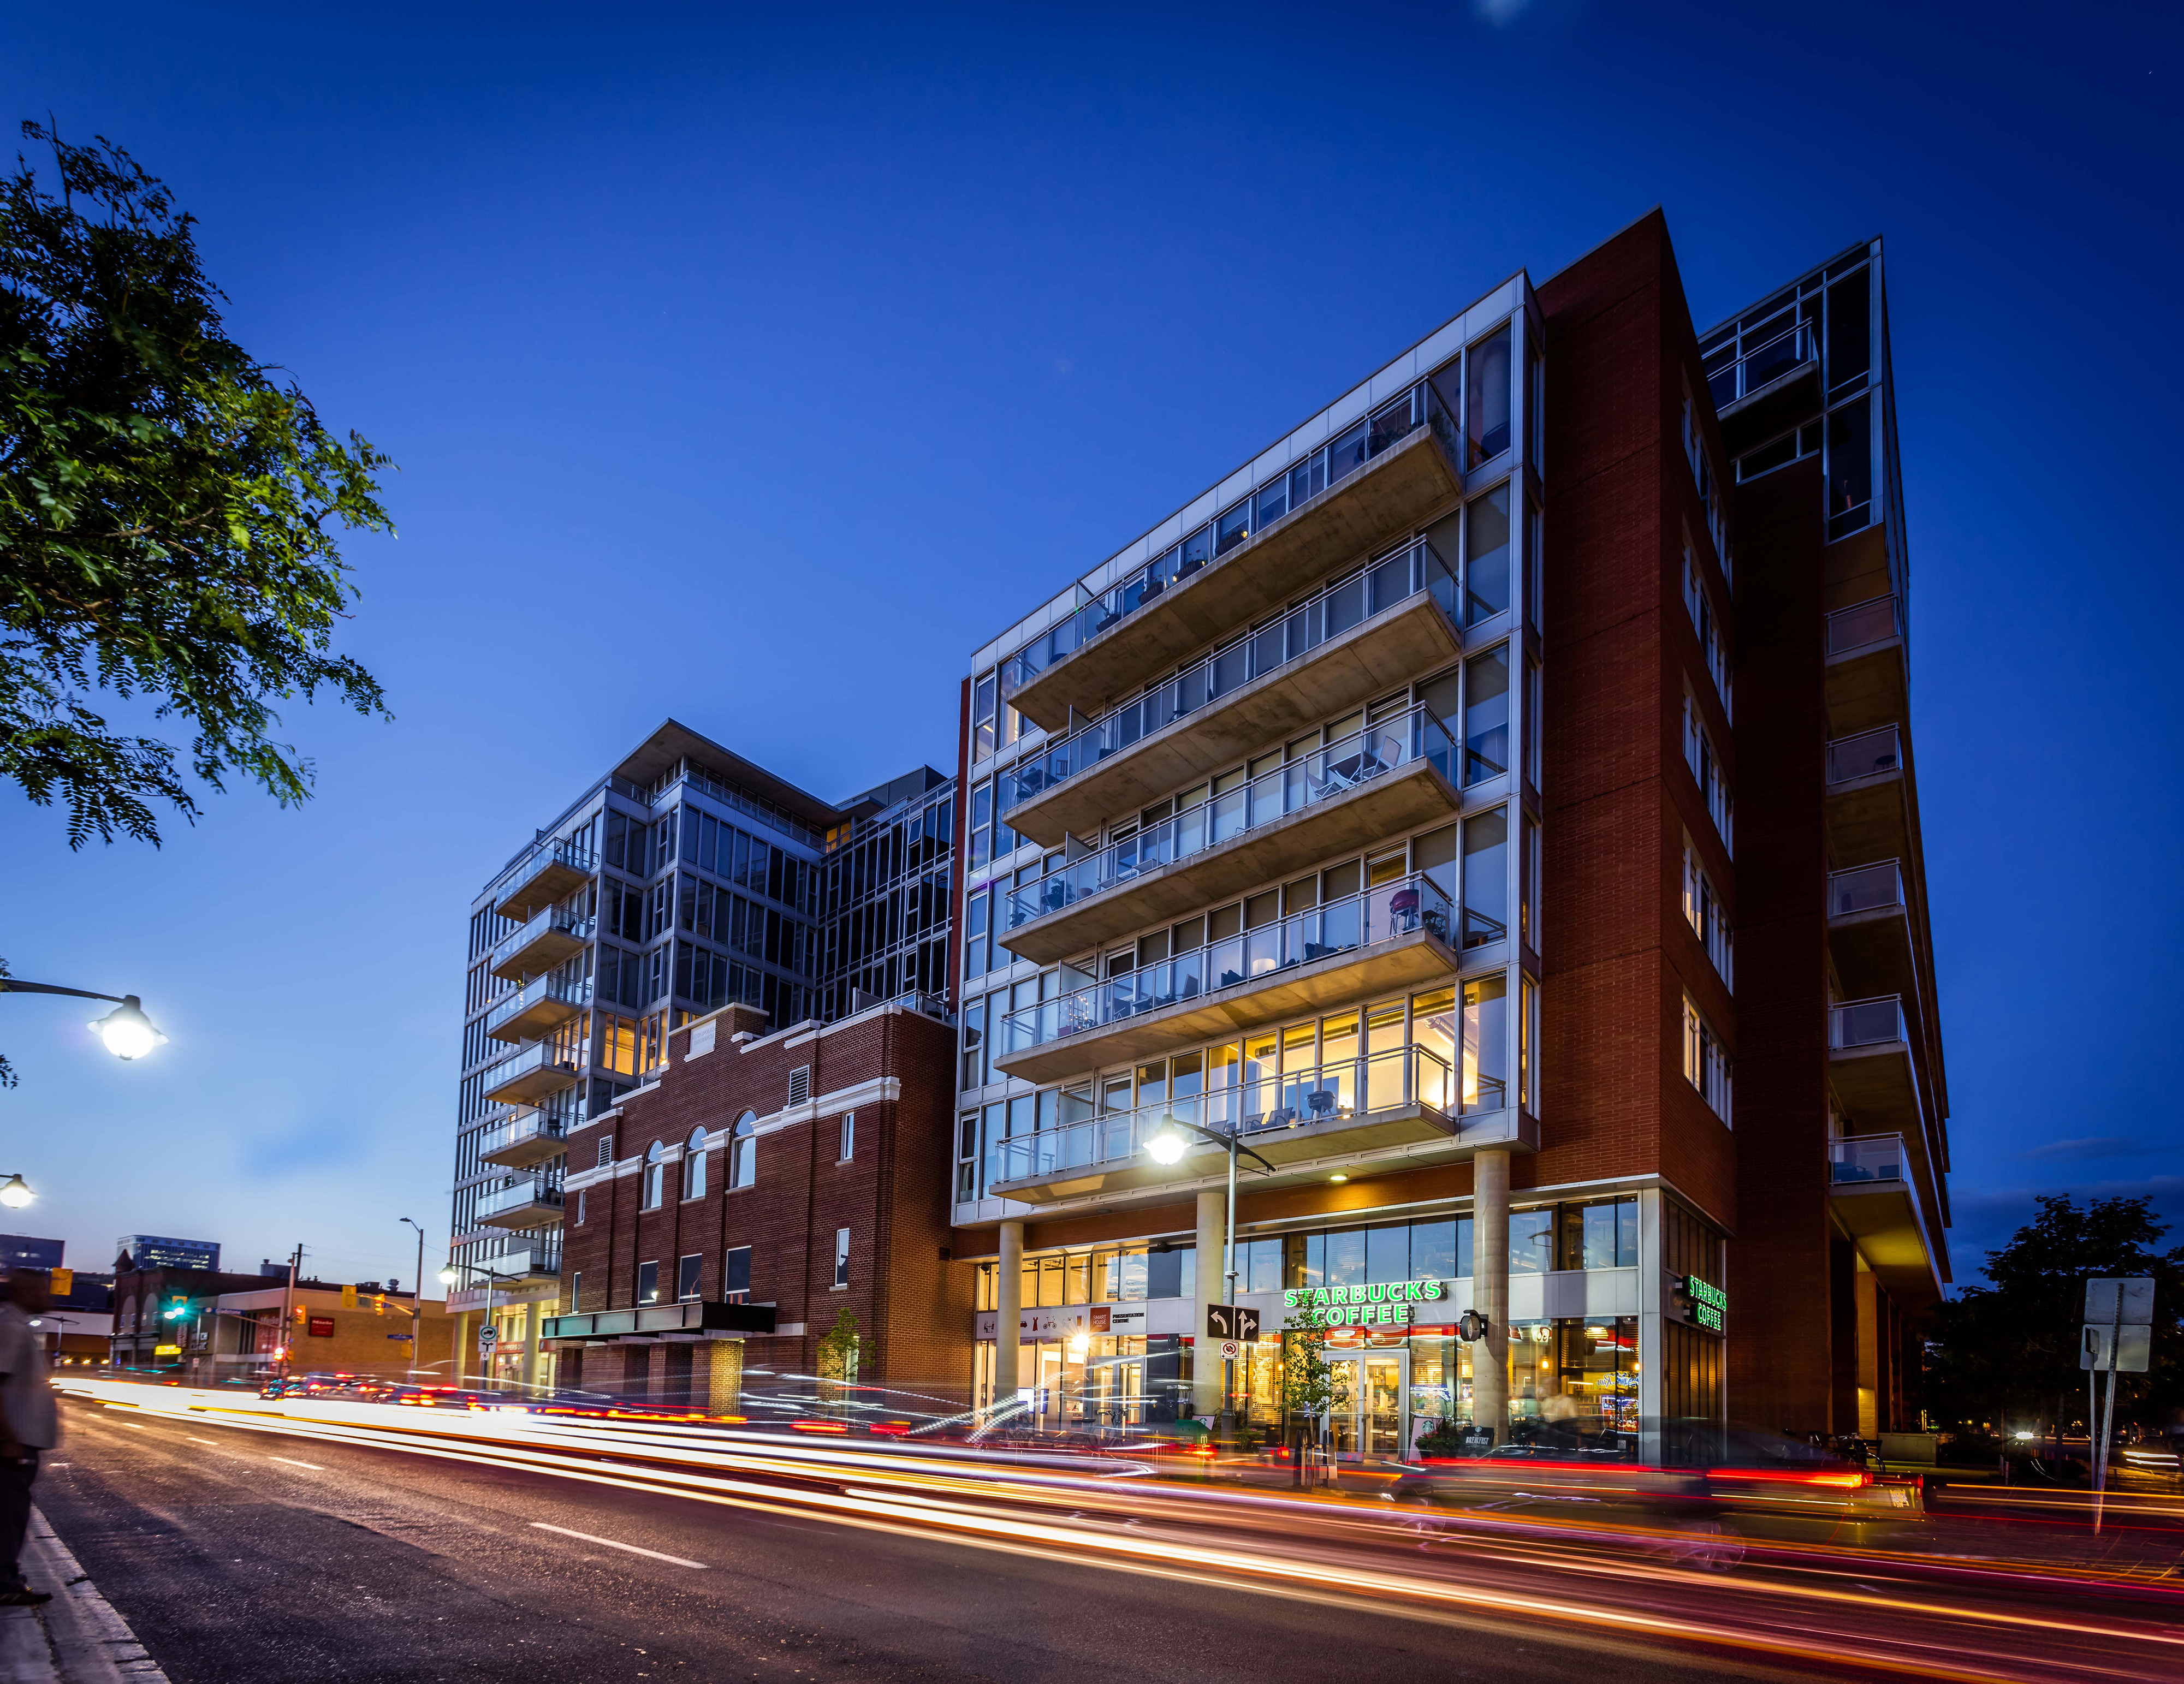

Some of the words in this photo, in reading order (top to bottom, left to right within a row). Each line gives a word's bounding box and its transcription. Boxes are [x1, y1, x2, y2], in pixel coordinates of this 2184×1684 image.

[1284, 1280, 1441, 1307] STARBUCKS
[1690, 1275, 1726, 1312] STARBUCKS
[1311, 1304, 1409, 1325] COFFEE
[1698, 1302, 1720, 1331] COFFEE
[1465, 1436, 1489, 1445] BREAKFAST
